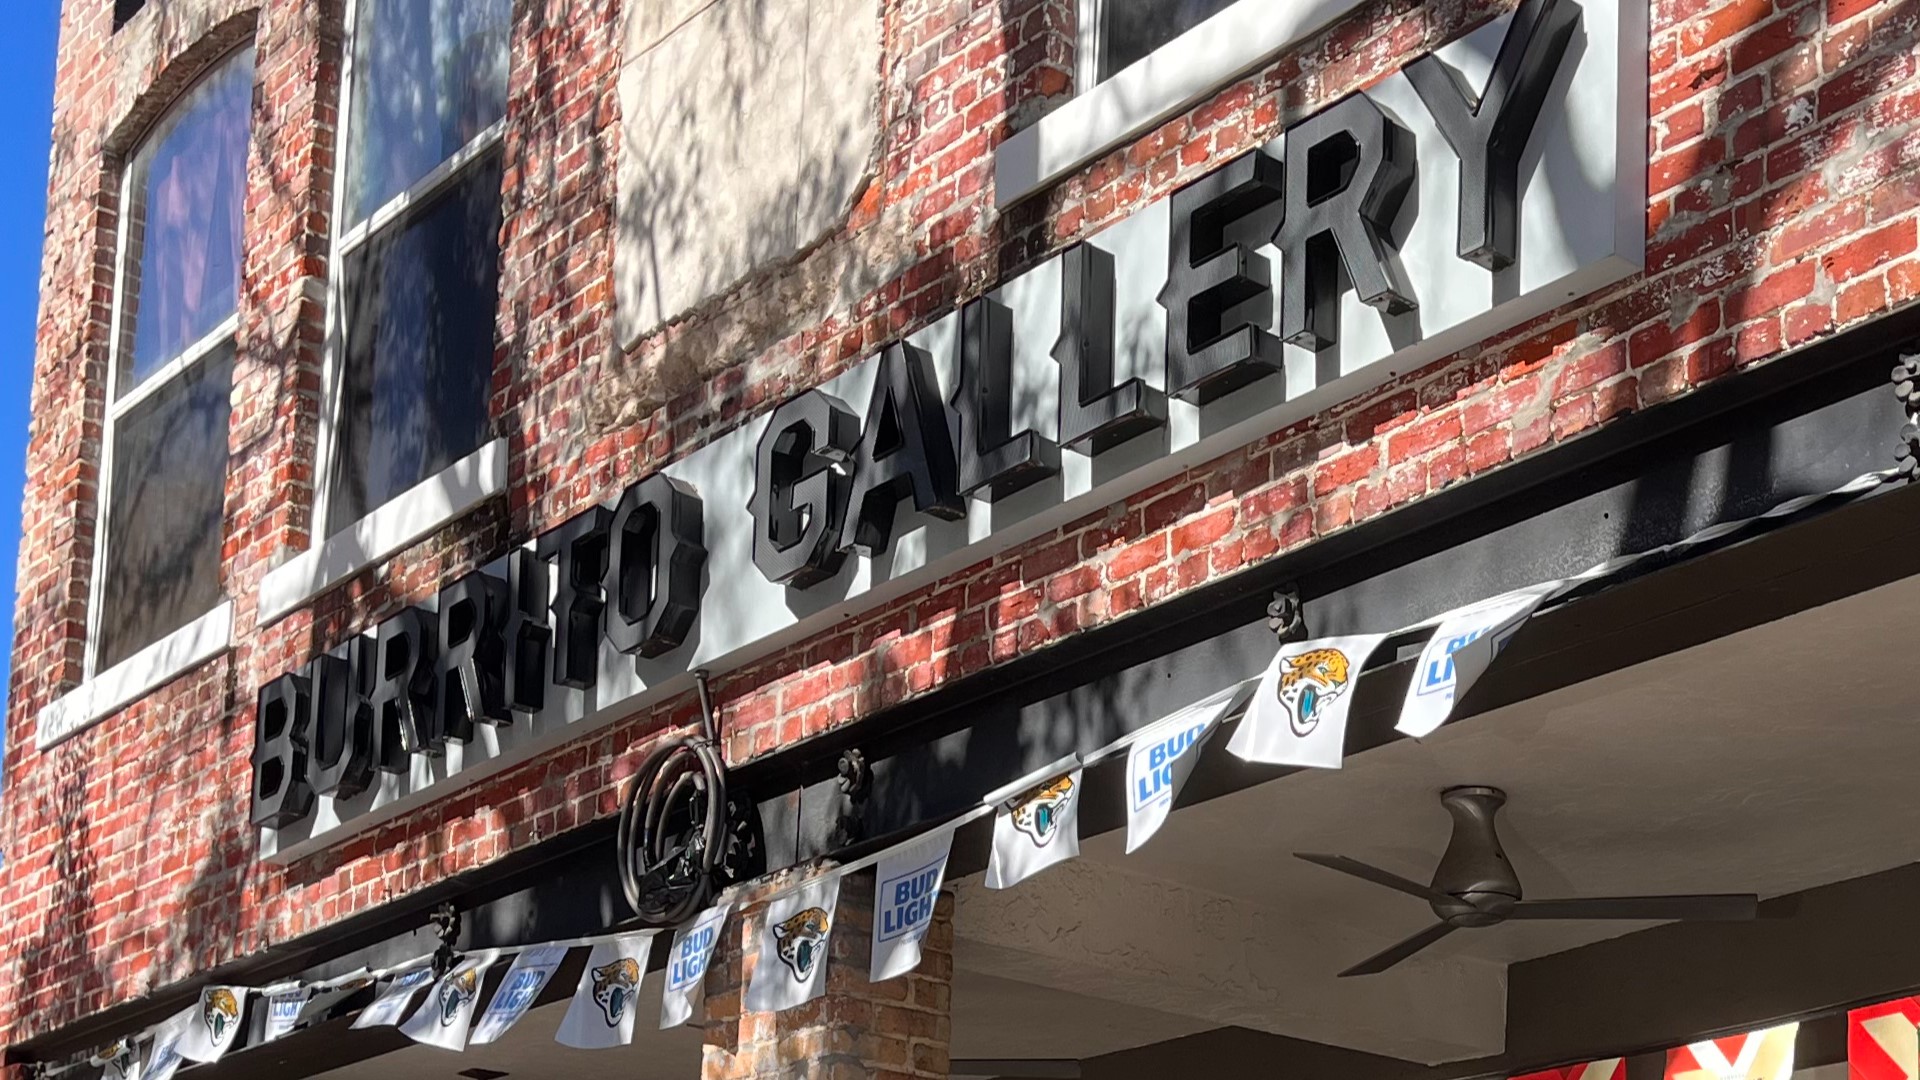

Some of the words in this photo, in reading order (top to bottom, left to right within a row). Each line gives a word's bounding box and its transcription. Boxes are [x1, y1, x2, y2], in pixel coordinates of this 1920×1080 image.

[251, 472, 709, 828] BURRITO
[746, 0, 1582, 588] GALLERY
[895, 868, 938, 906] BUD
[682, 927, 714, 959] BUD
[511, 970, 546, 991] BUD
[272, 1000, 299, 1017] LIGH
[493, 988, 538, 1010] LIGH
